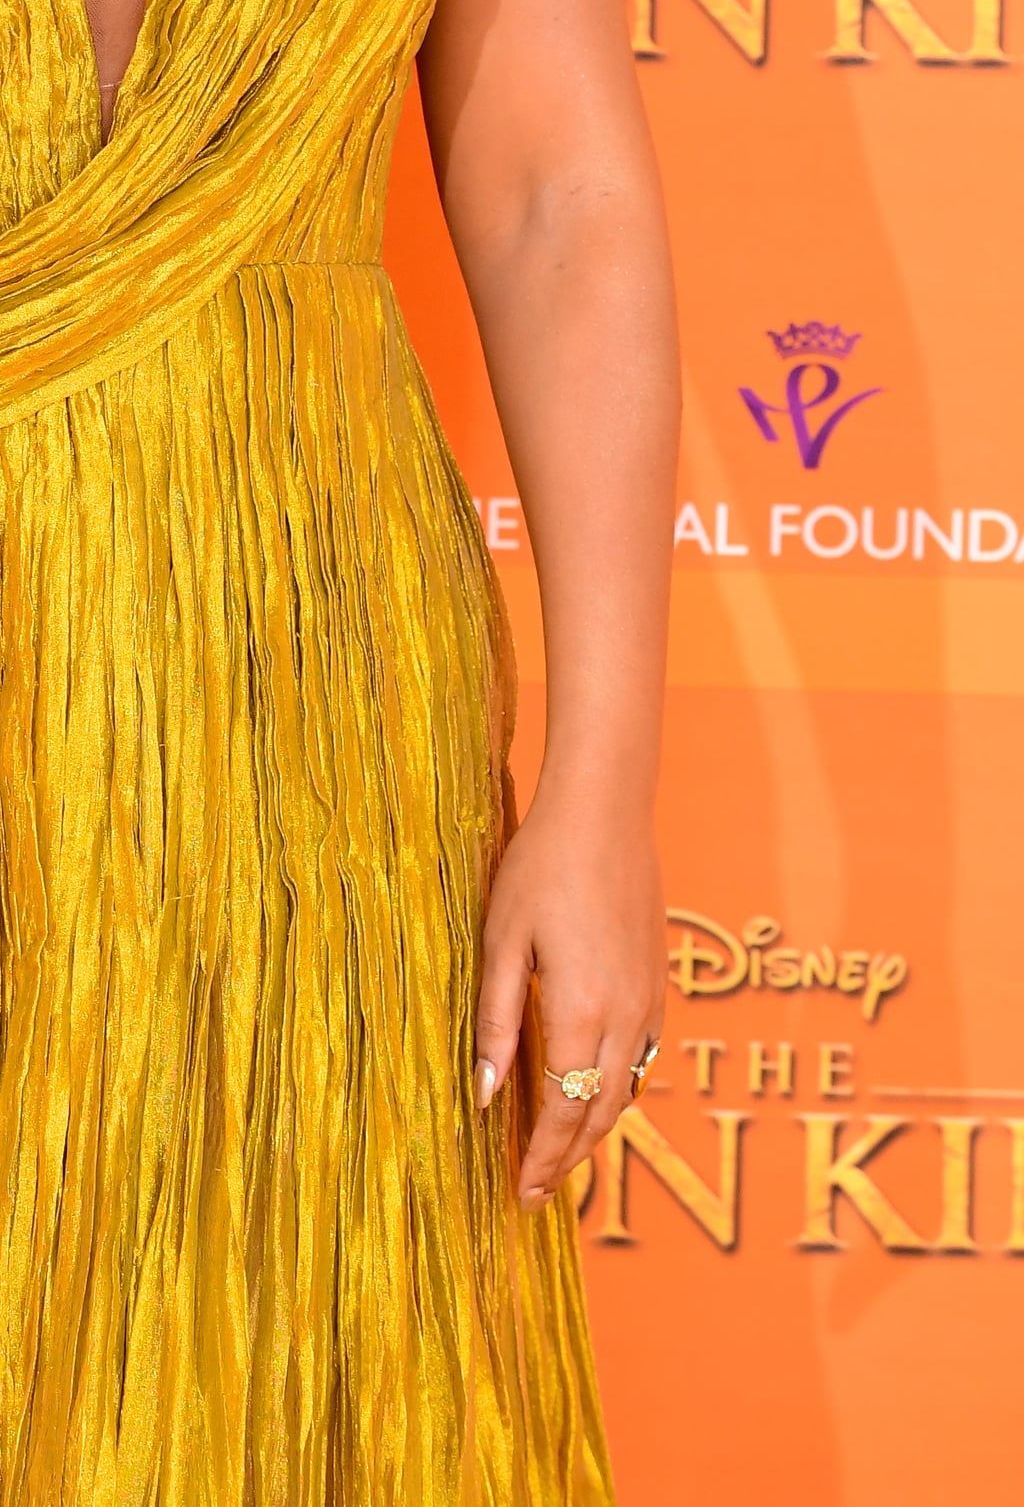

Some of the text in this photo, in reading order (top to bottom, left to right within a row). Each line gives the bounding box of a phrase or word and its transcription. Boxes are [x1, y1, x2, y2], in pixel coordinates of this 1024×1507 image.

[473, 497, 521, 550] E
[770, 504, 1024, 564] FOUND
[681, 1039, 856, 1098] THE
[578, 1107, 750, 1254] N
